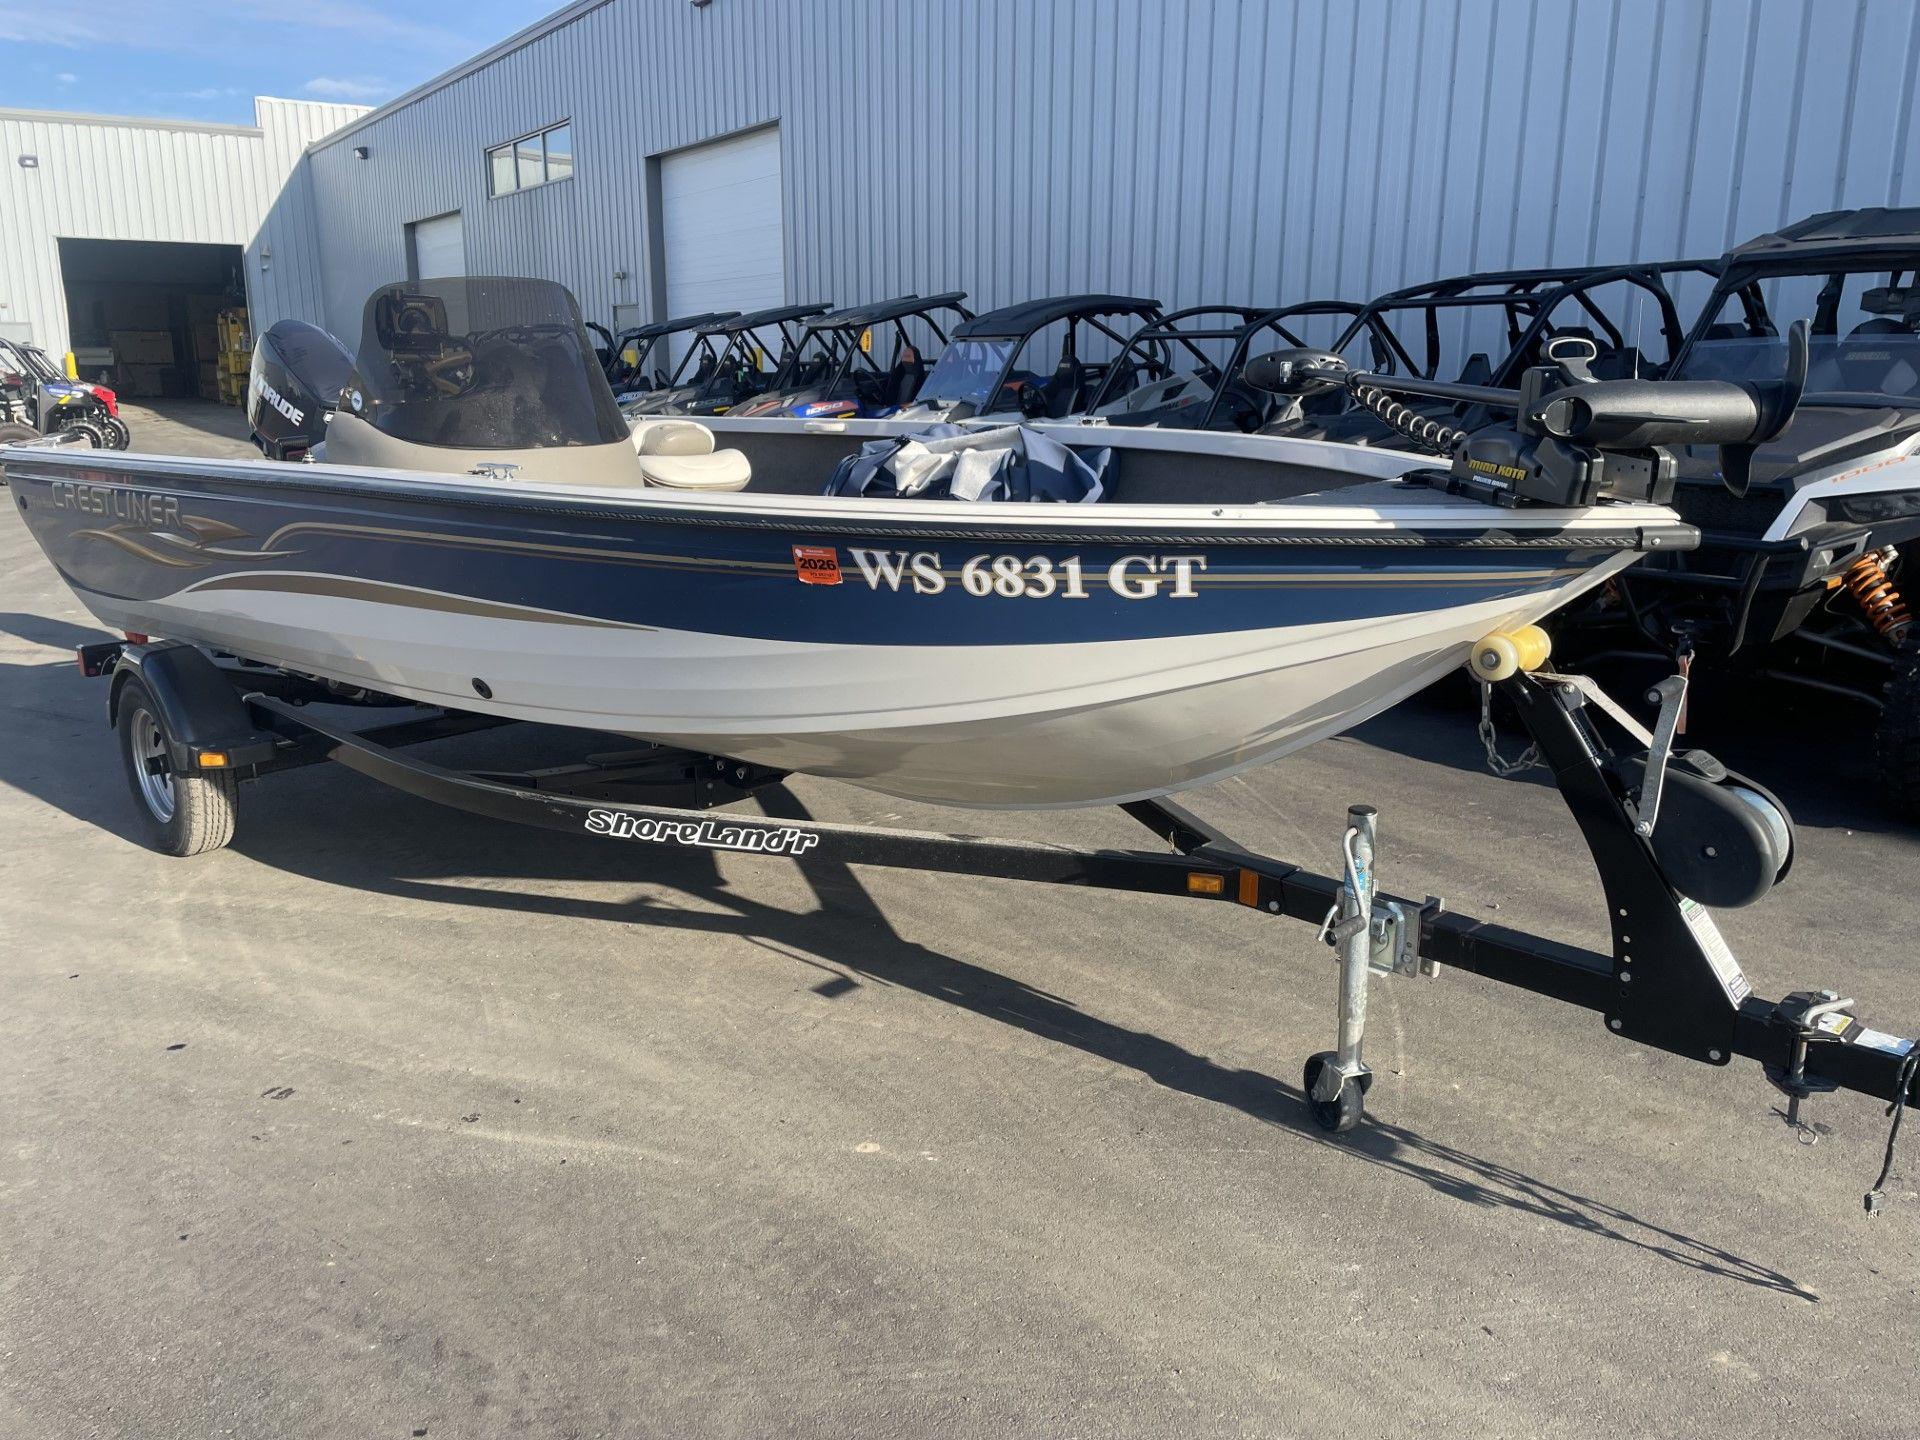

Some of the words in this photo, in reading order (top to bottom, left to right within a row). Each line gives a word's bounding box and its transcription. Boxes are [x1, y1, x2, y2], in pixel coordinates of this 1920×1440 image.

[805, 401, 844, 415] 1000
[1498, 465, 1528, 480] KOTA
[1831, 456, 1907, 484] 1000
[51, 482, 183, 528] CRESTLINER
[798, 558, 837, 571] 2026
[848, 547, 946, 594] WS
[962, 555, 1088, 598] 6831
[1108, 555, 1207, 599] GT
[585, 809, 818, 854] ShoreLand'r
